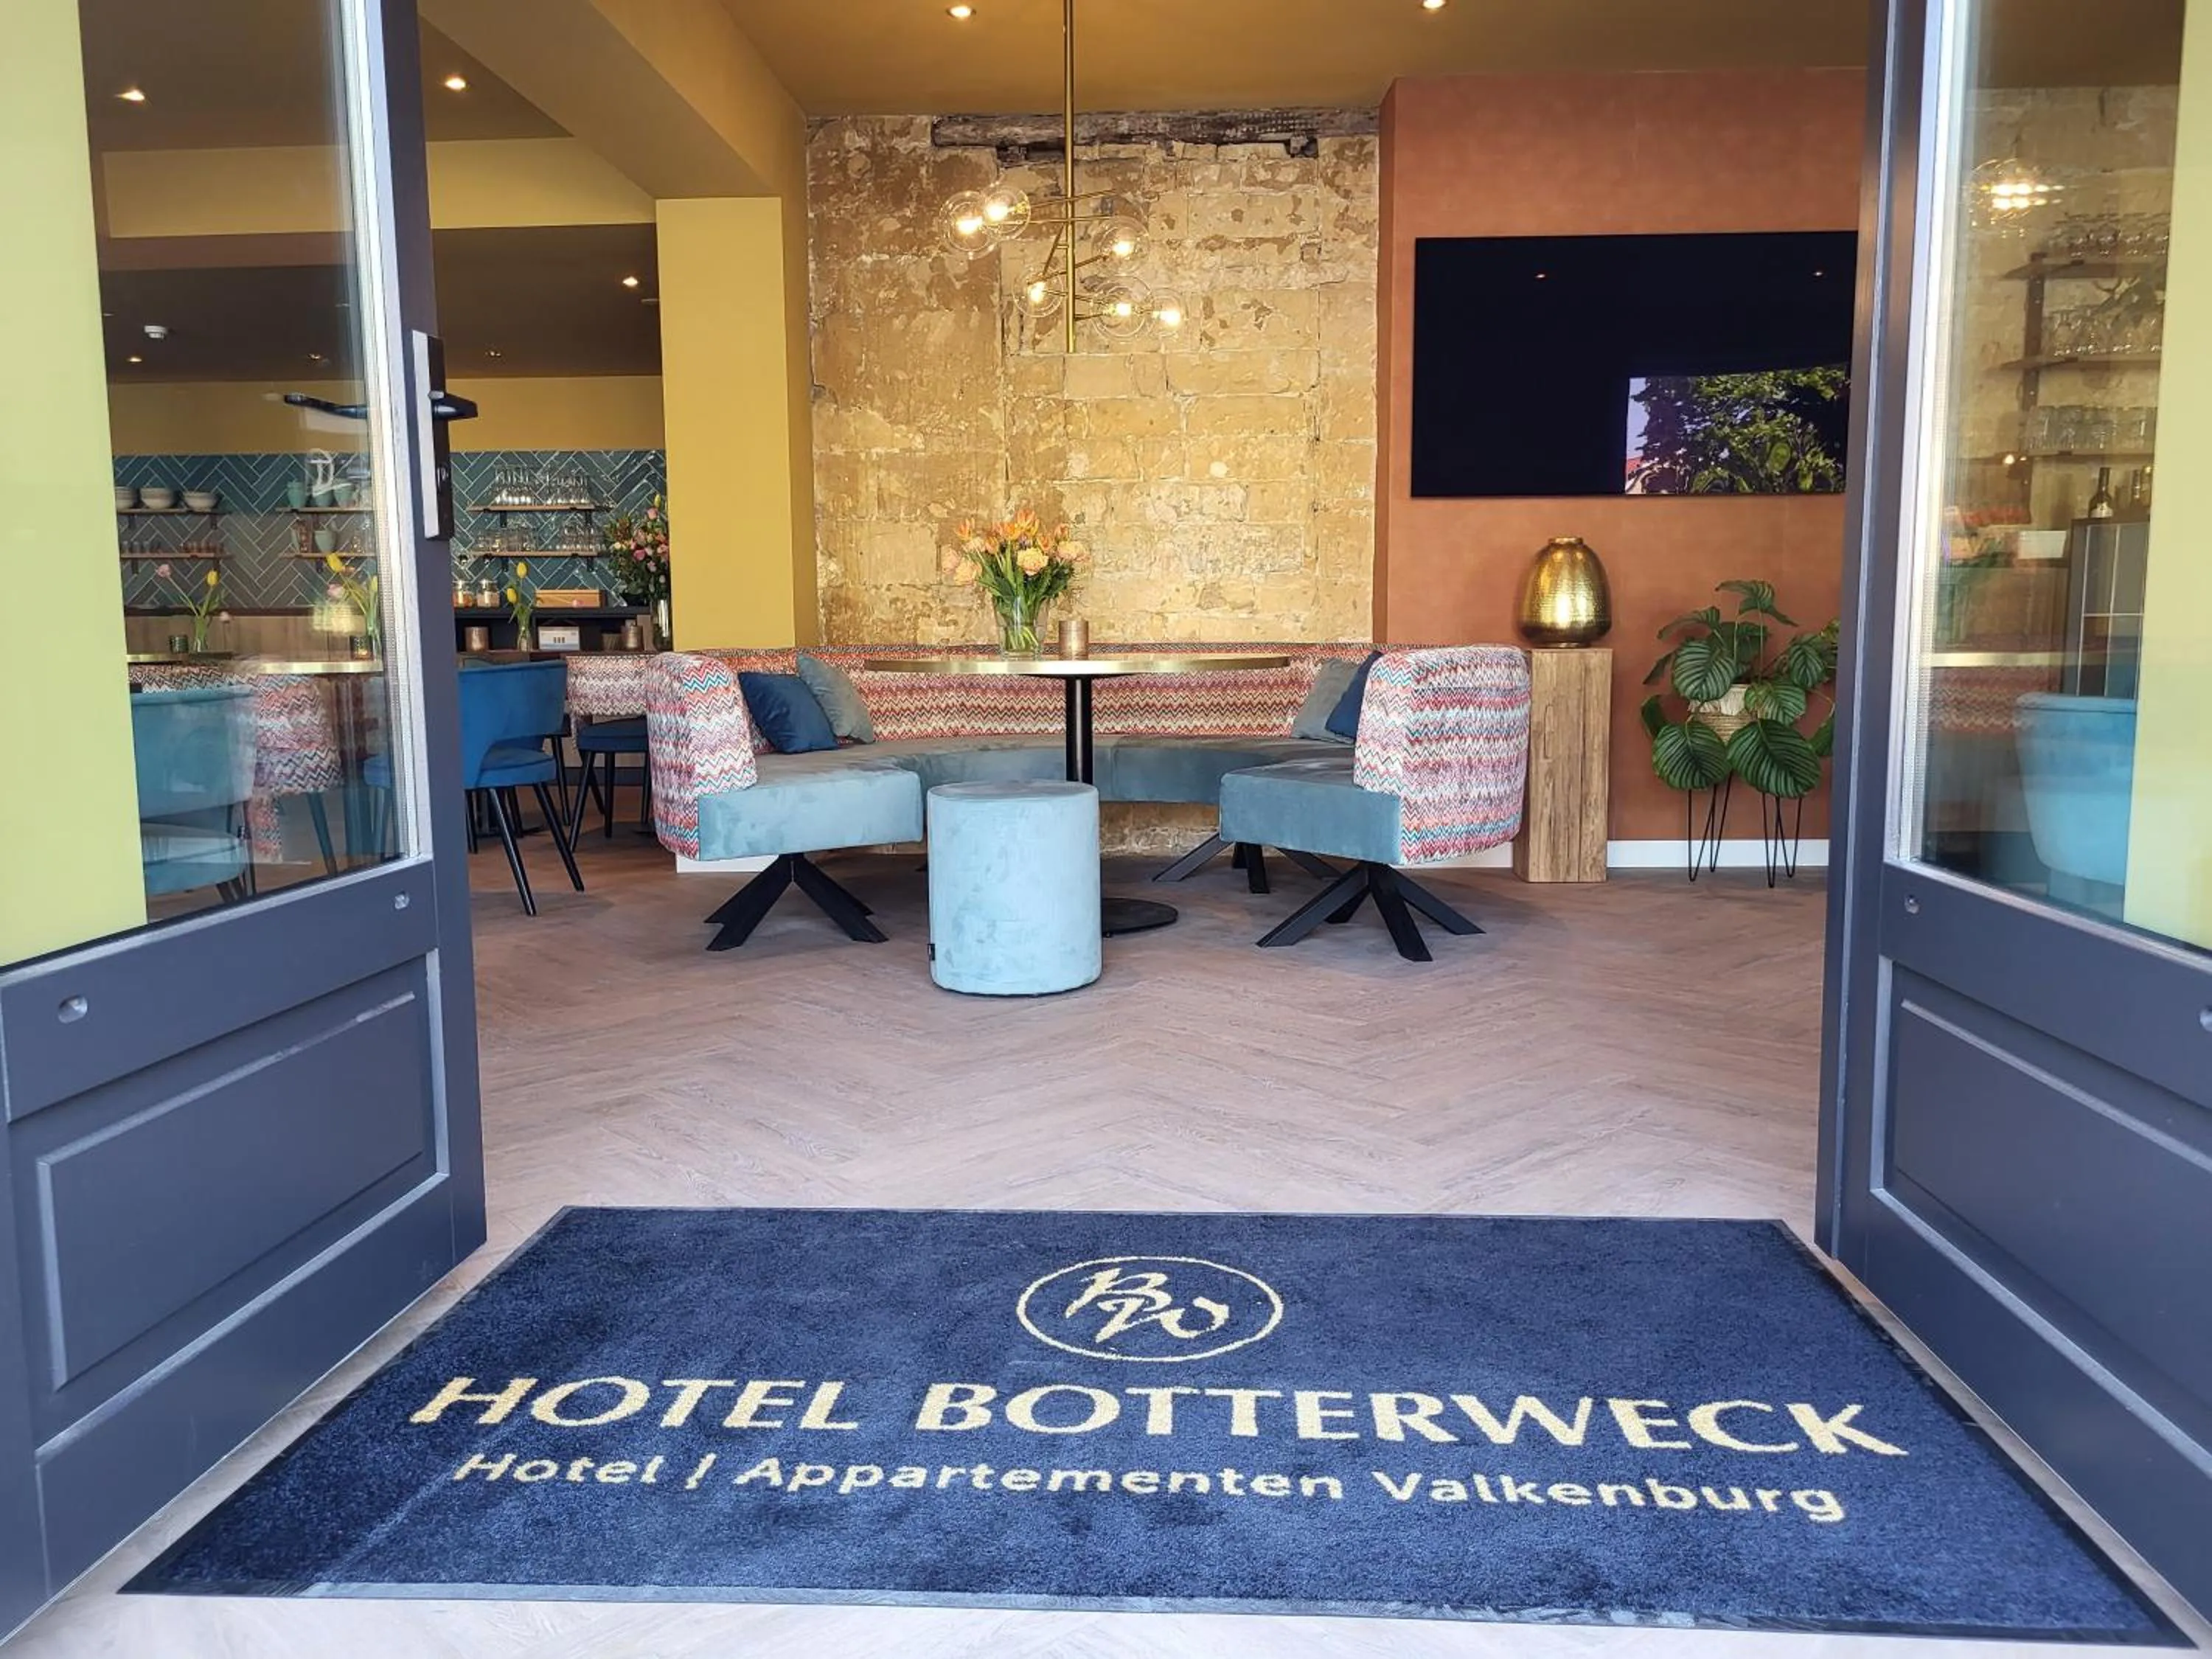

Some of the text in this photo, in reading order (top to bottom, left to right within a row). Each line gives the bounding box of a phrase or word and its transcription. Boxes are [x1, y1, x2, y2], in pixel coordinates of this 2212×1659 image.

[409, 1376, 1907, 1455] HOTEL BOTTERWECK
[454, 1453, 665, 1484] Hotel
[733, 1457, 1343, 1499] Appartementen
[1373, 1472, 1845, 1521] Valkenburg
